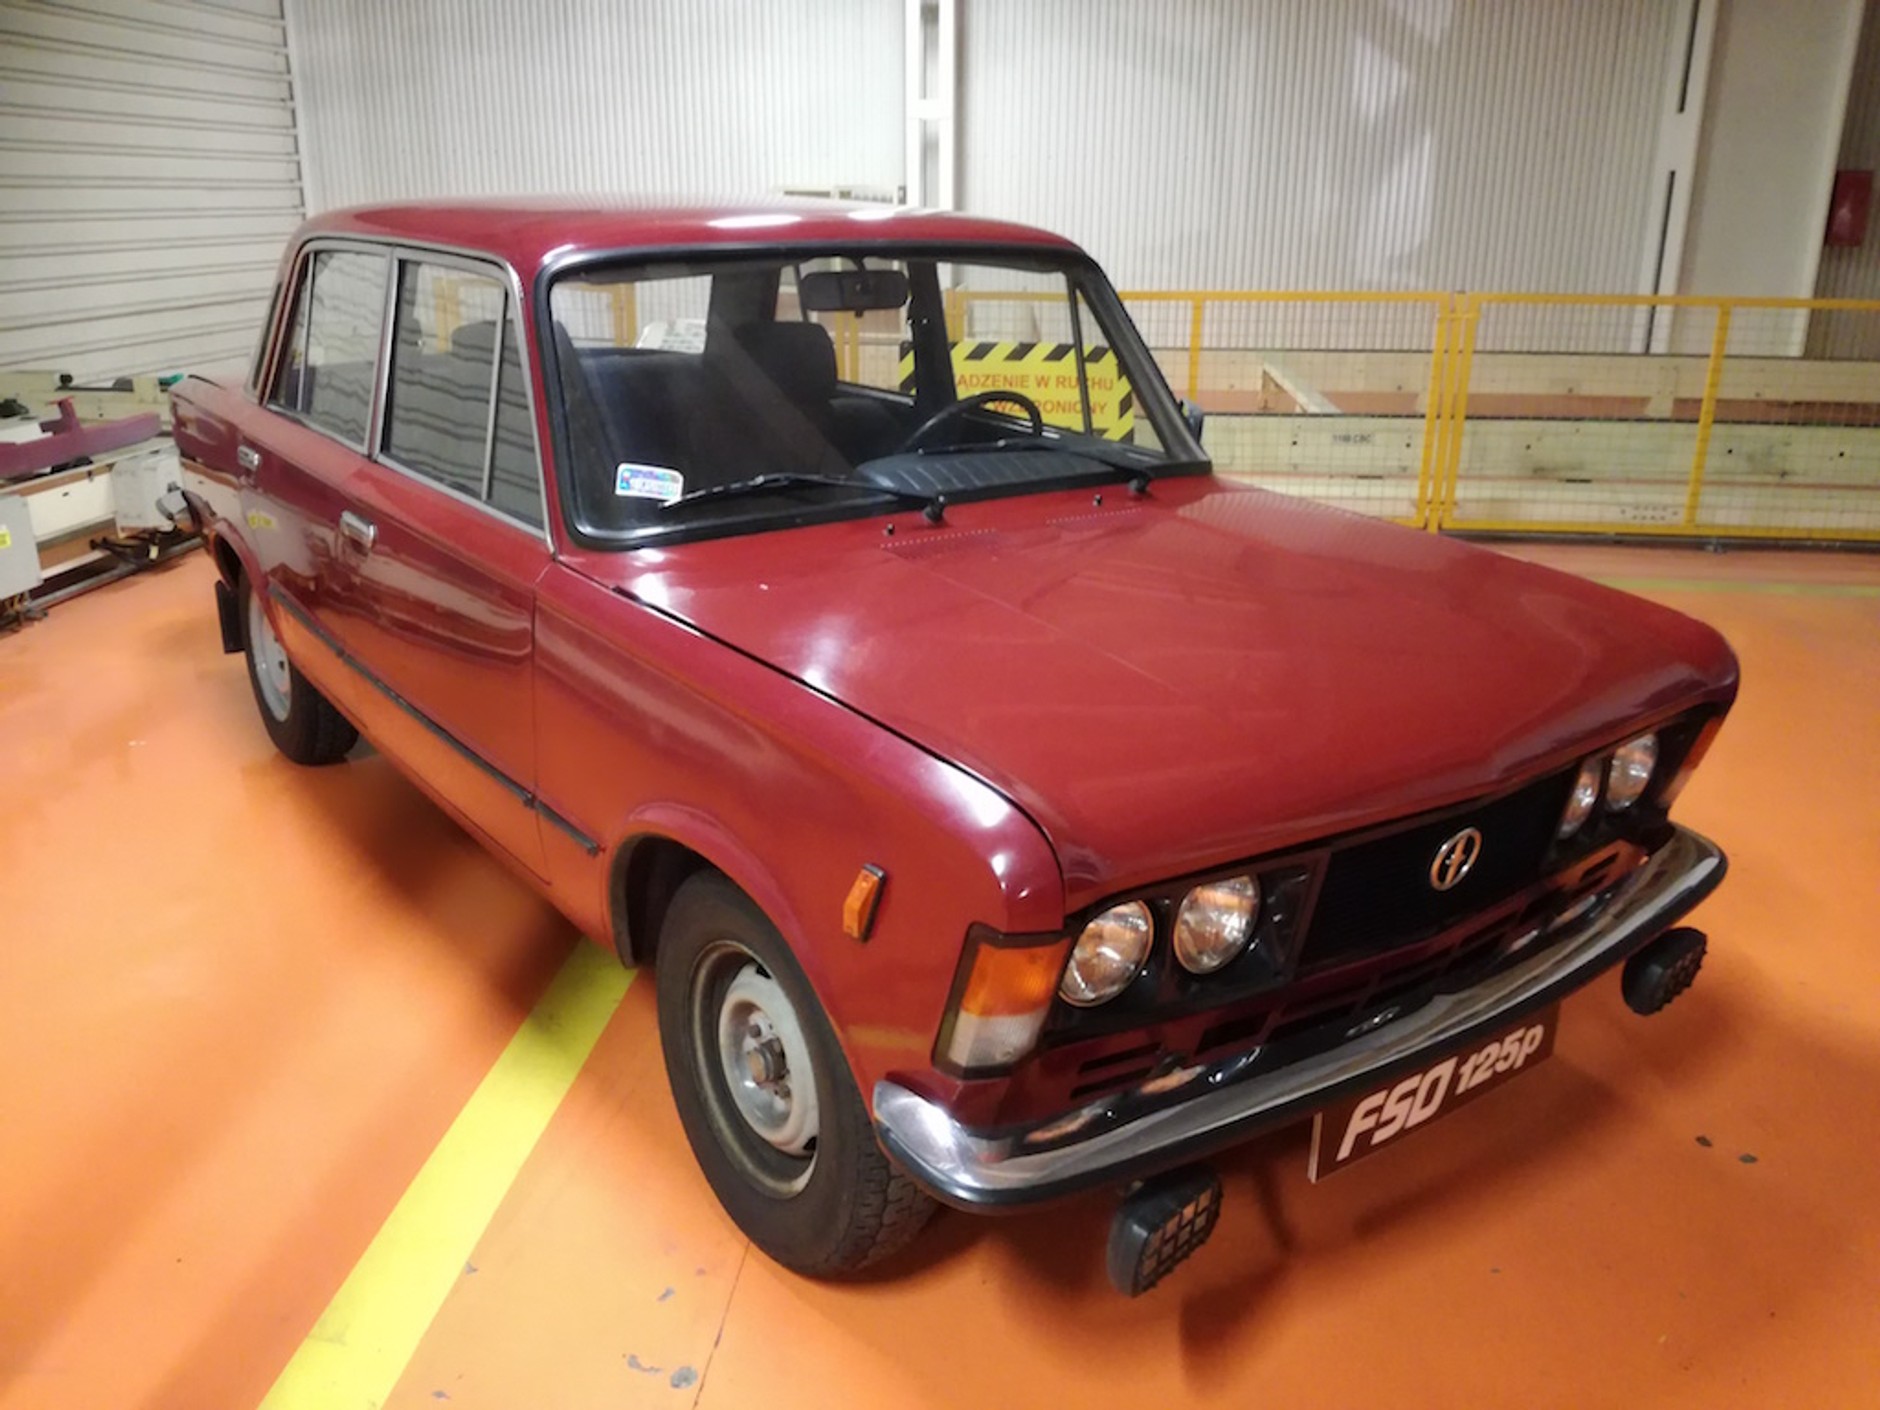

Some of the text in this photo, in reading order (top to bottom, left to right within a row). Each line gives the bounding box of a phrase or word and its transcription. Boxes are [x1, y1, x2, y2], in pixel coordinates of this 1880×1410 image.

[957, 374, 1030, 390] ĄDZENIE
[1035, 376, 1049, 389] W
[1335, 1023, 1544, 1163] FSO 125p
